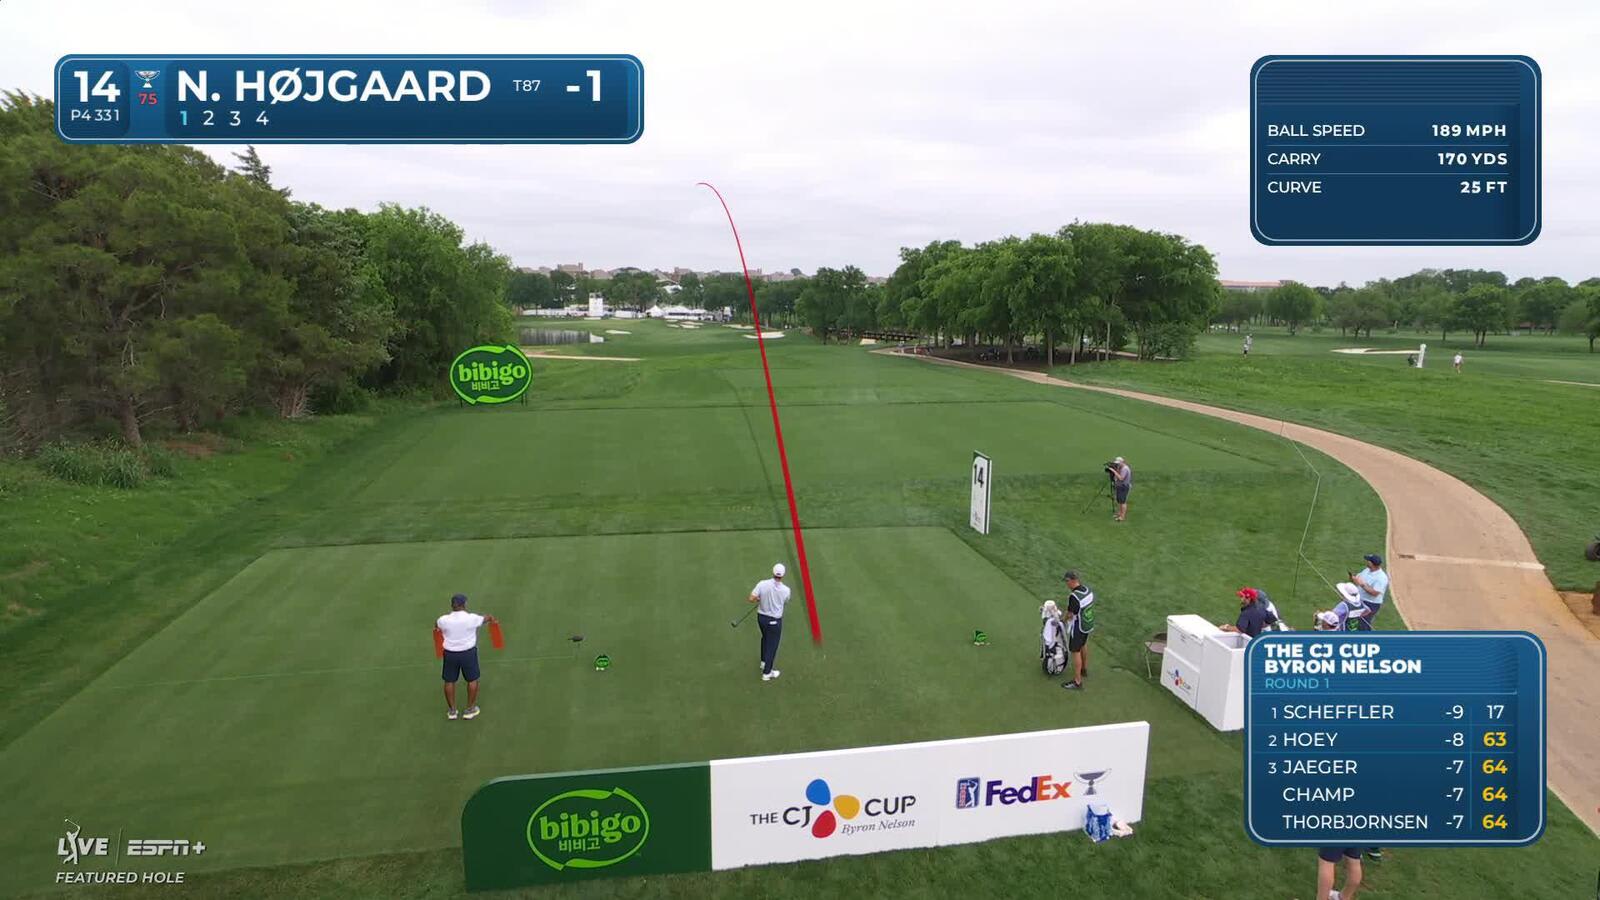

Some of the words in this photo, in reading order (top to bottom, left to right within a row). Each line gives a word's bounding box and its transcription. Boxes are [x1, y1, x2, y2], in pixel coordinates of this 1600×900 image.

[458, 361, 526, 385] bibigo
[471, 381, 500, 391] 비비고
[973, 463, 985, 489] 14
[985, 775, 1073, 806] FedEx
[750, 812, 779, 826] THE
[782, 805, 813, 828] CJ
[864, 795, 917, 817] CUP
[540, 810, 641, 843] bibigo
[841, 823, 877, 836] Byron
[878, 818, 916, 831] Nelson
[559, 838, 601, 852] 비비고
